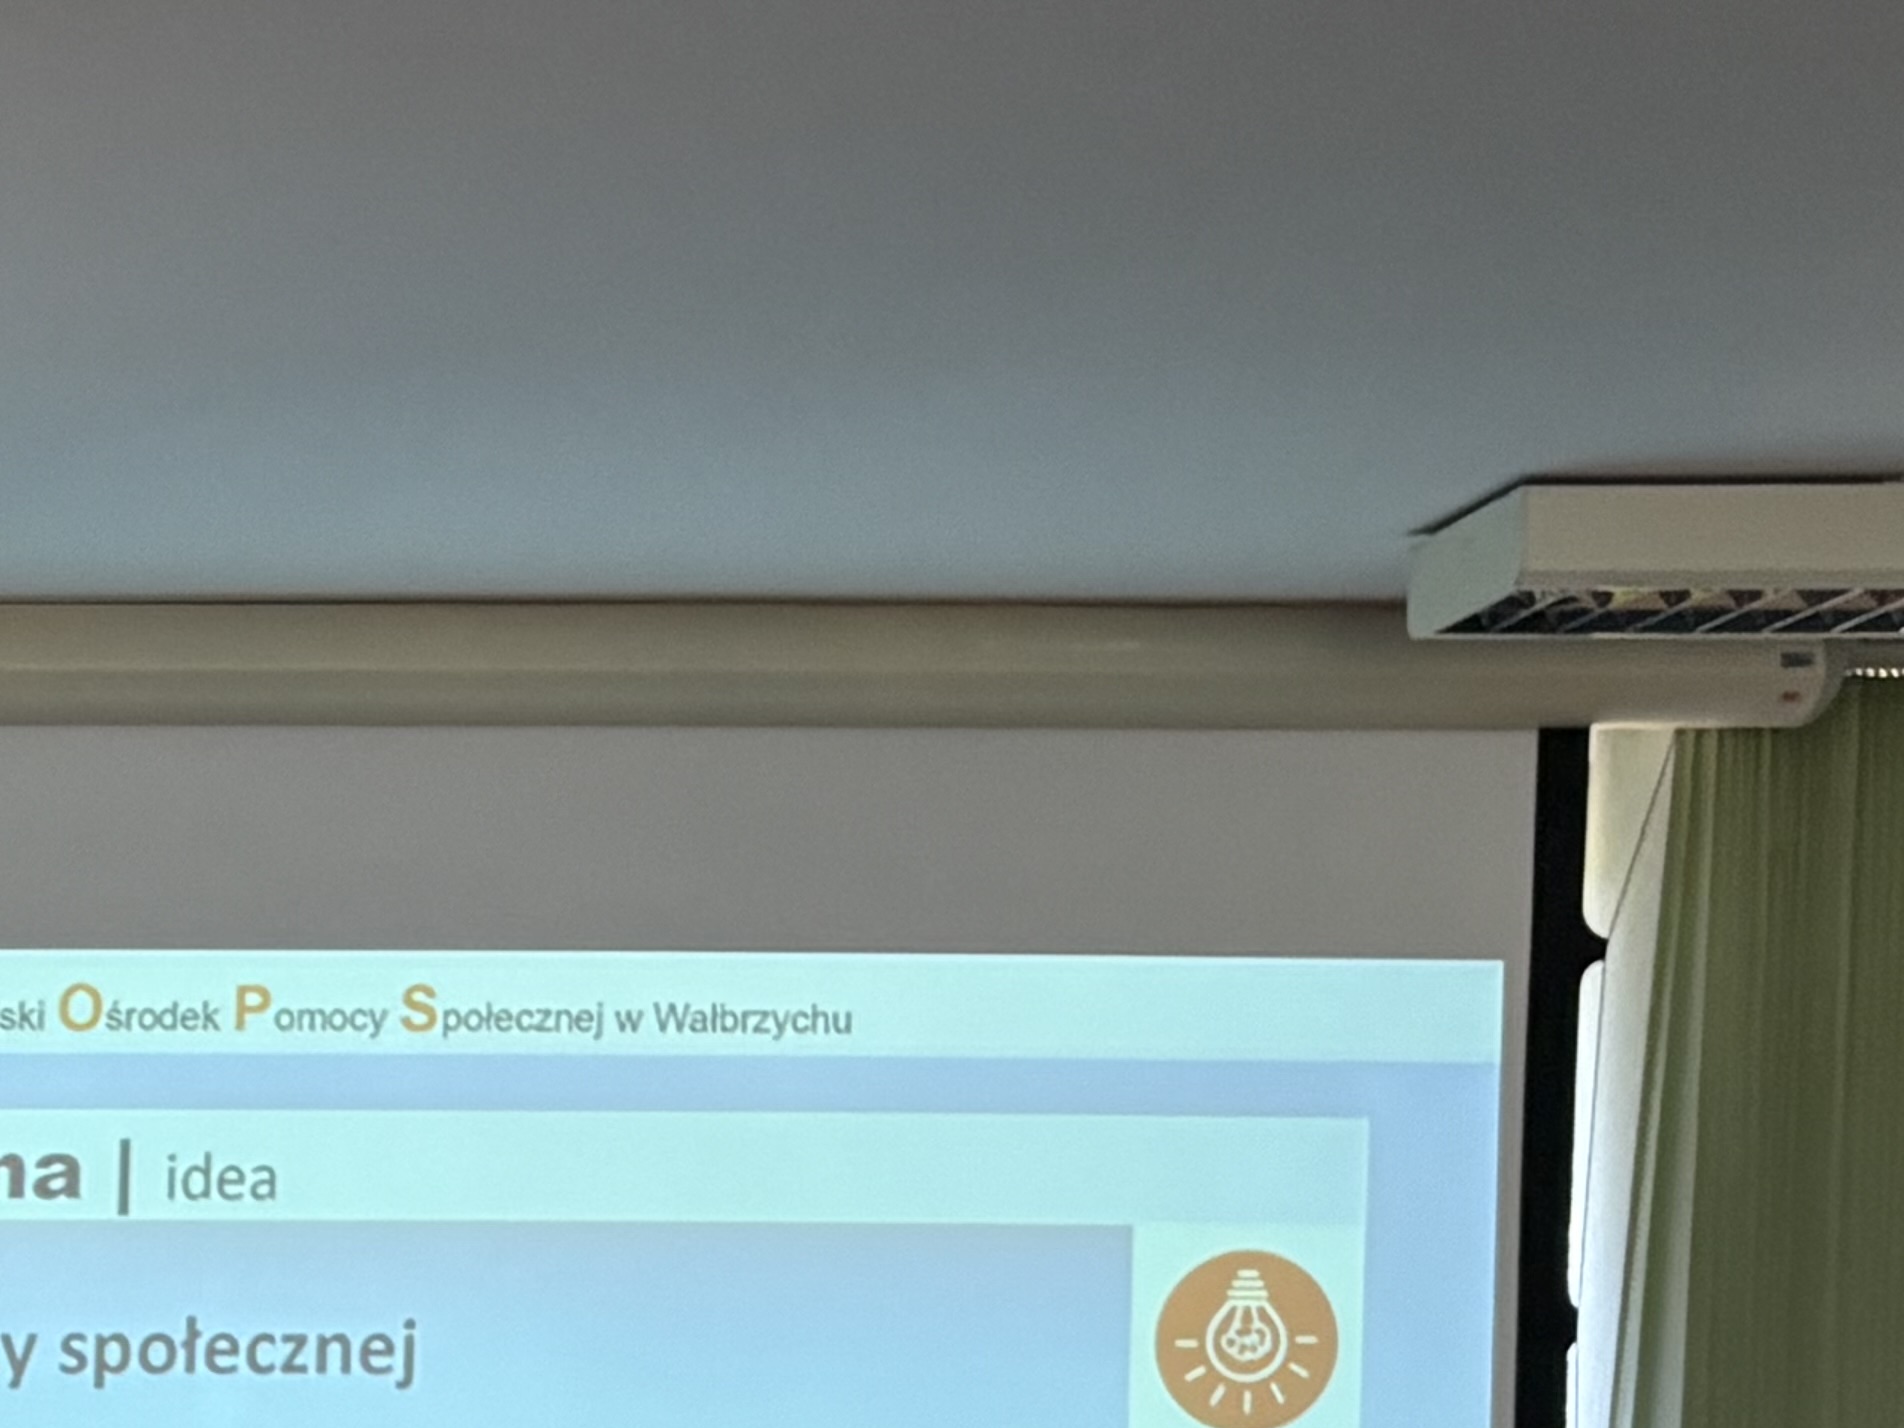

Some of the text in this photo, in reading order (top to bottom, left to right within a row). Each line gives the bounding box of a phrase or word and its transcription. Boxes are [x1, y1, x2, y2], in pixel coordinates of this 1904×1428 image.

[58, 982, 220, 1033] Ośrodek
[233, 983, 389, 1039] Pomocy
[400, 983, 604, 1041] Społecznej
[614, 1007, 644, 1034] w
[652, 1001, 853, 1041] Wałbrzychu
[164, 1152, 279, 1202] idea
[58, 1315, 417, 1391] społecznej
